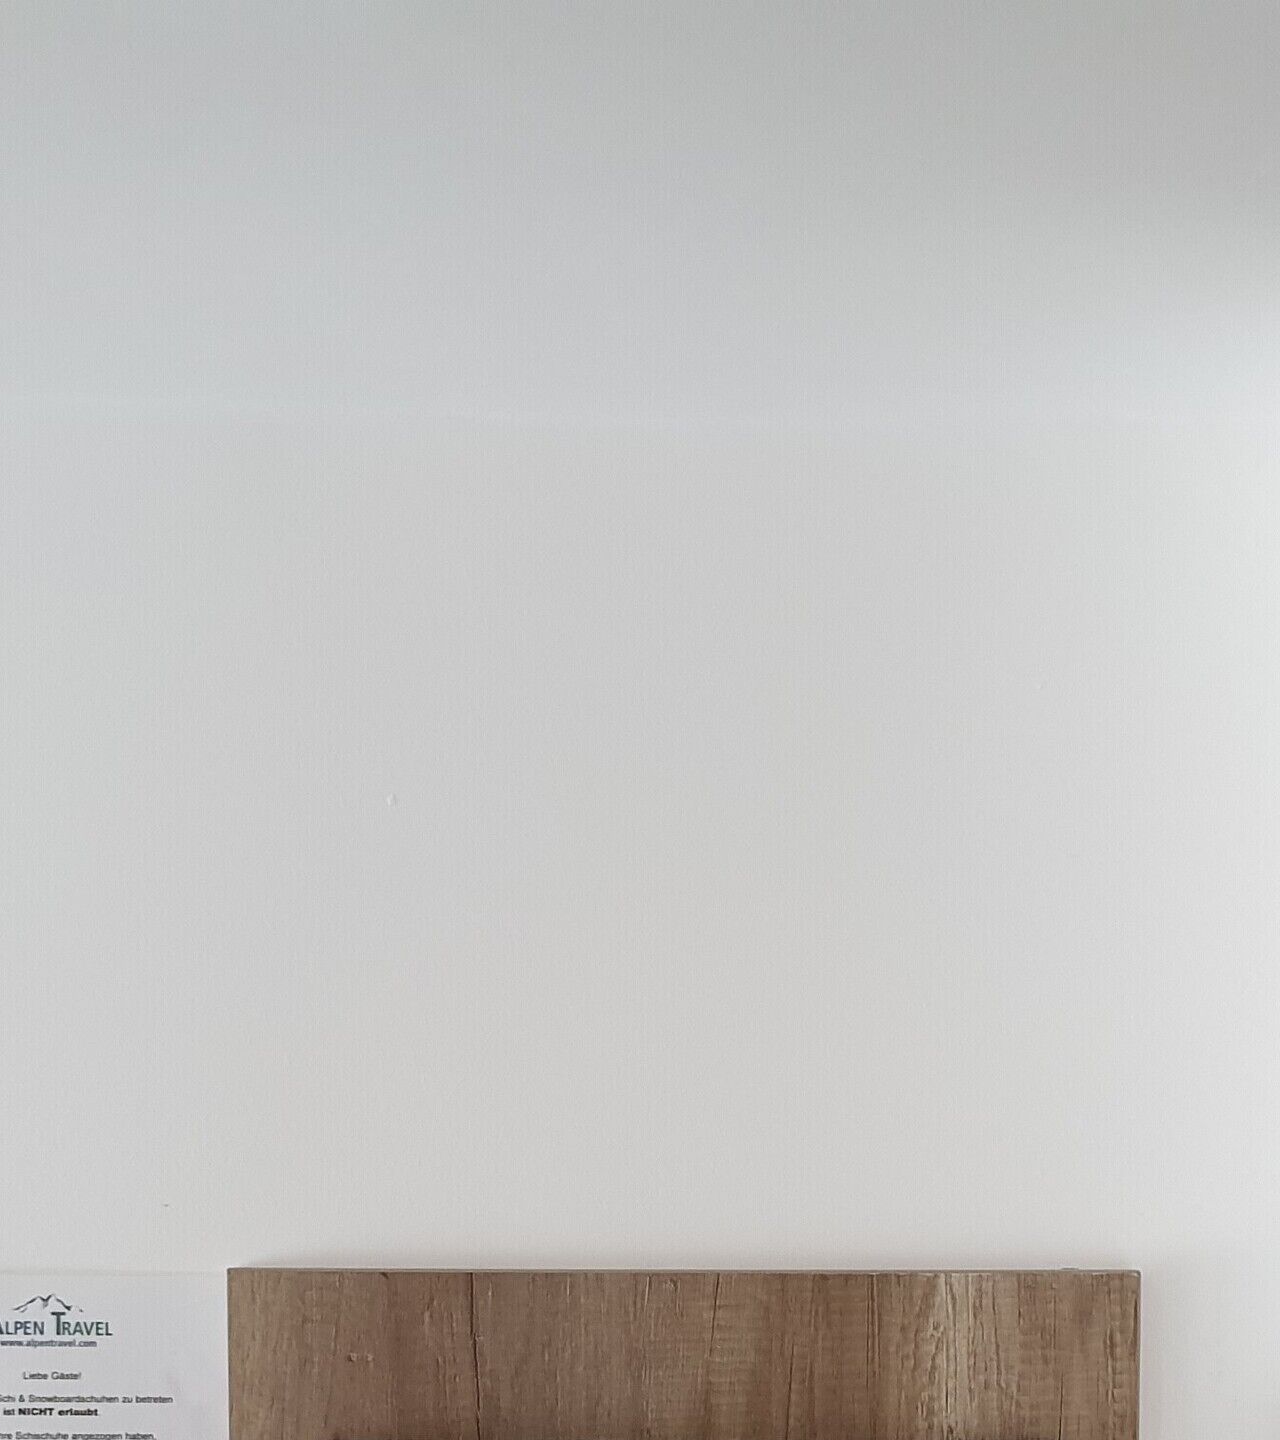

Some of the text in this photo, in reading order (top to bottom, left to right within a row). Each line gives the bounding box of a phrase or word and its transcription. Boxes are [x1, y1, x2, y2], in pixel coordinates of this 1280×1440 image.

[50, 1311, 114, 1336] TRAVEL
[0, 1339, 98, 1349] www.alpentravel.com
[22, 1371, 49, 1380] Liebe
[121, 1396, 134, 1404] zu
[135, 1395, 174, 1404] betreten
[2, 1407, 16, 1417] ist
[18, 1407, 55, 1417] NICHT
